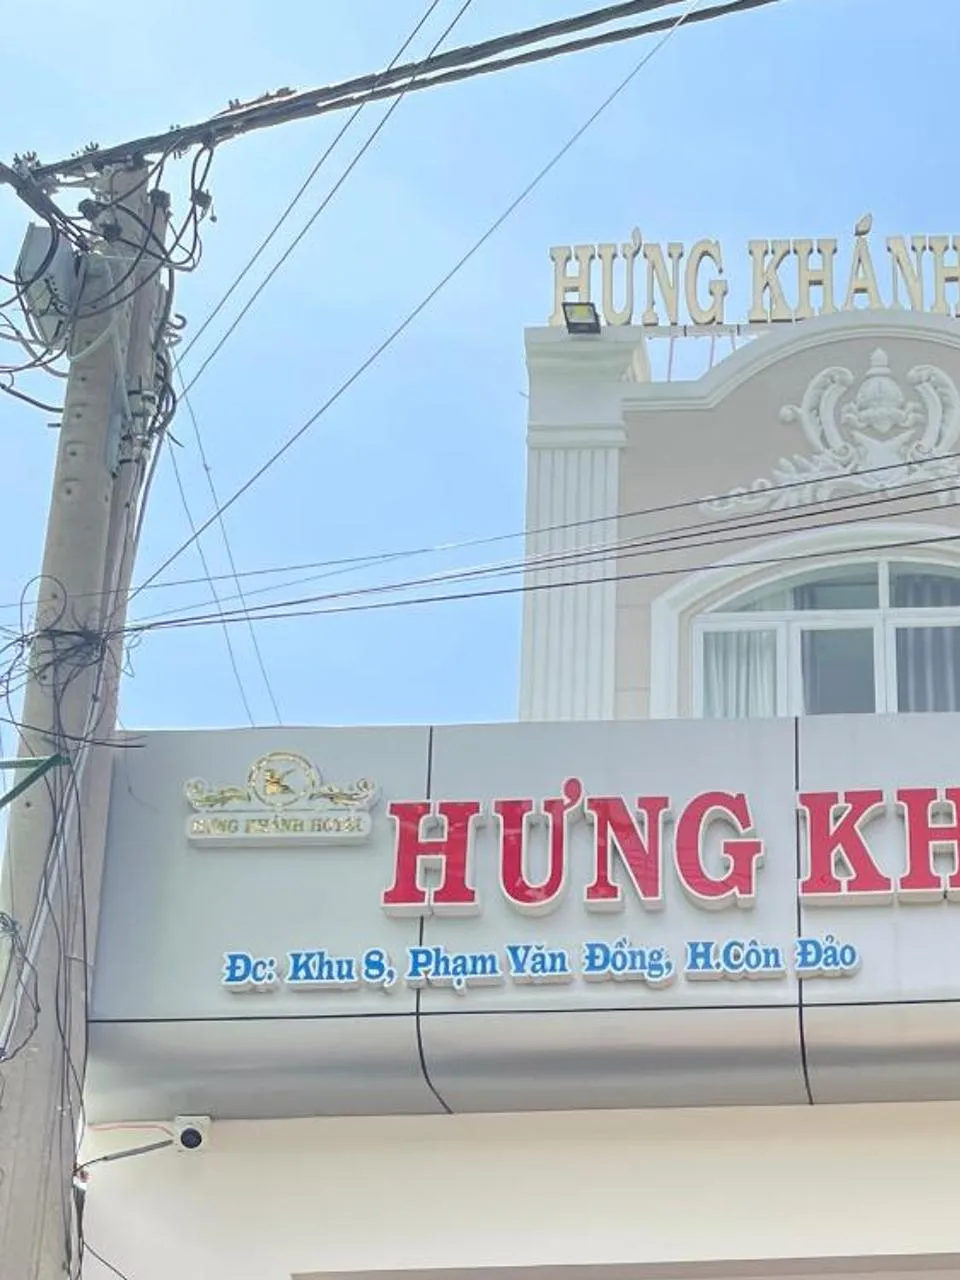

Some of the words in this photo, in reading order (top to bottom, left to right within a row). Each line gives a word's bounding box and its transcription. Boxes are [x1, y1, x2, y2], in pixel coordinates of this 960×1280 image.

[549, 226, 728, 325] HƯNG
[382, 777, 763, 907] HƯNG
[224, 952, 275, 983] Đc:
[288, 950, 356, 982] Khu
[363, 948, 396, 986] 8,
[406, 946, 500, 988] Phạm
[506, 943, 570, 975] Văn
[584, 937, 673, 979] Đồng,
[686, 938, 783, 972] H.Côn
[796, 934, 858, 969] Đảo
